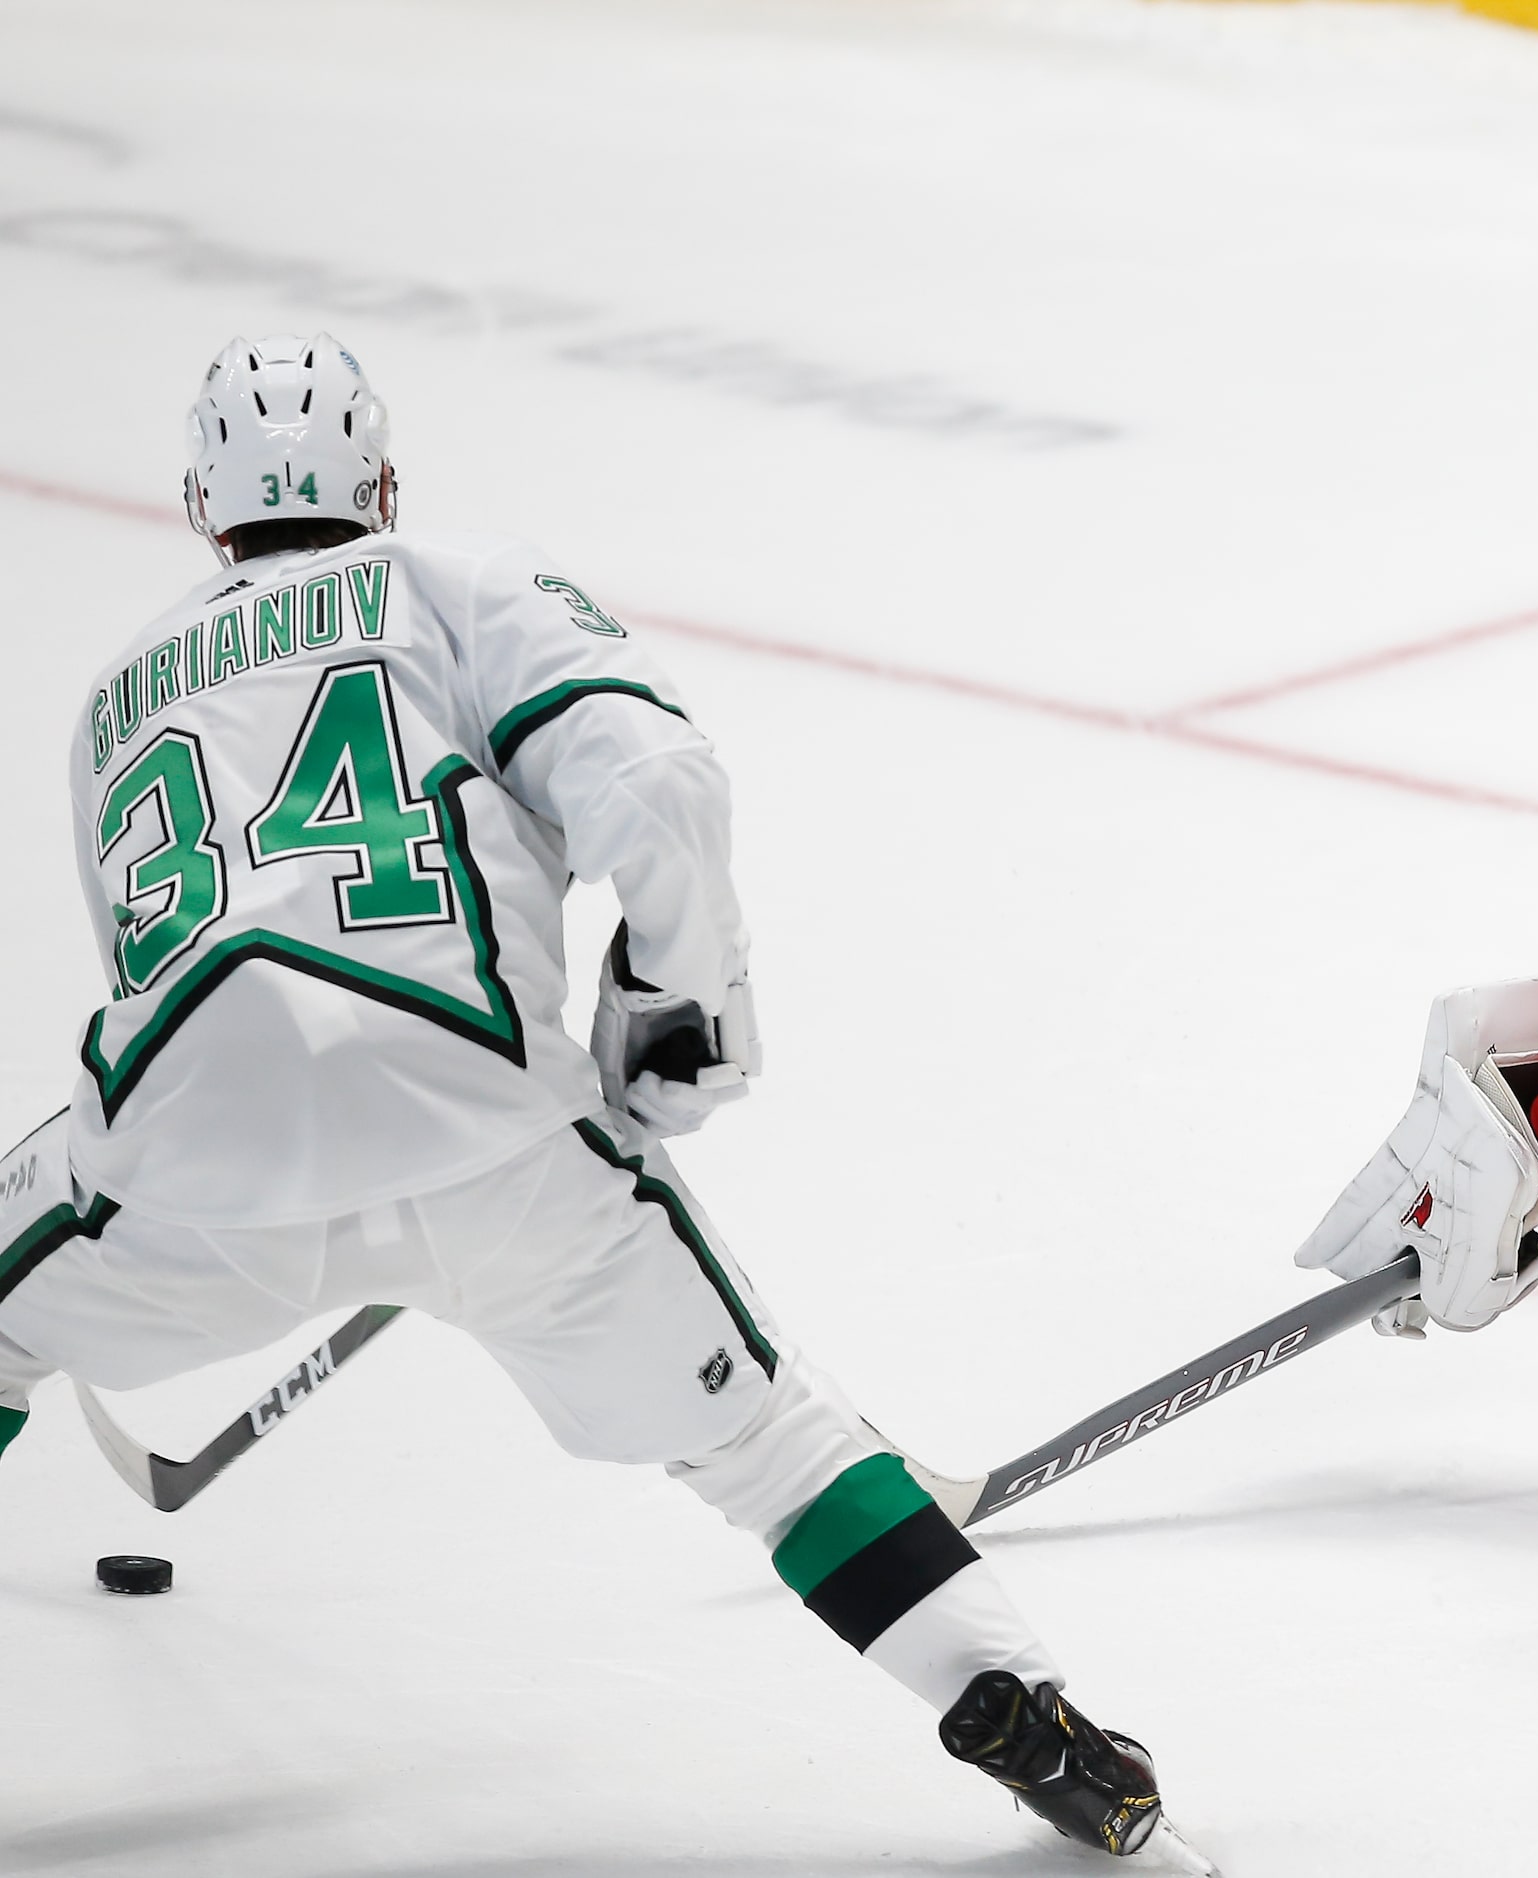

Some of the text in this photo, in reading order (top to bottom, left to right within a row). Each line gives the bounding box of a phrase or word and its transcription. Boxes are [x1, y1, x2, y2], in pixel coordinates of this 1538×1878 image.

[91, 560, 391, 774] GURIANOV
[96, 659, 457, 996] 34
[249, 1338, 338, 1438] CCM
[986, 1323, 1309, 1512] SUPREME
